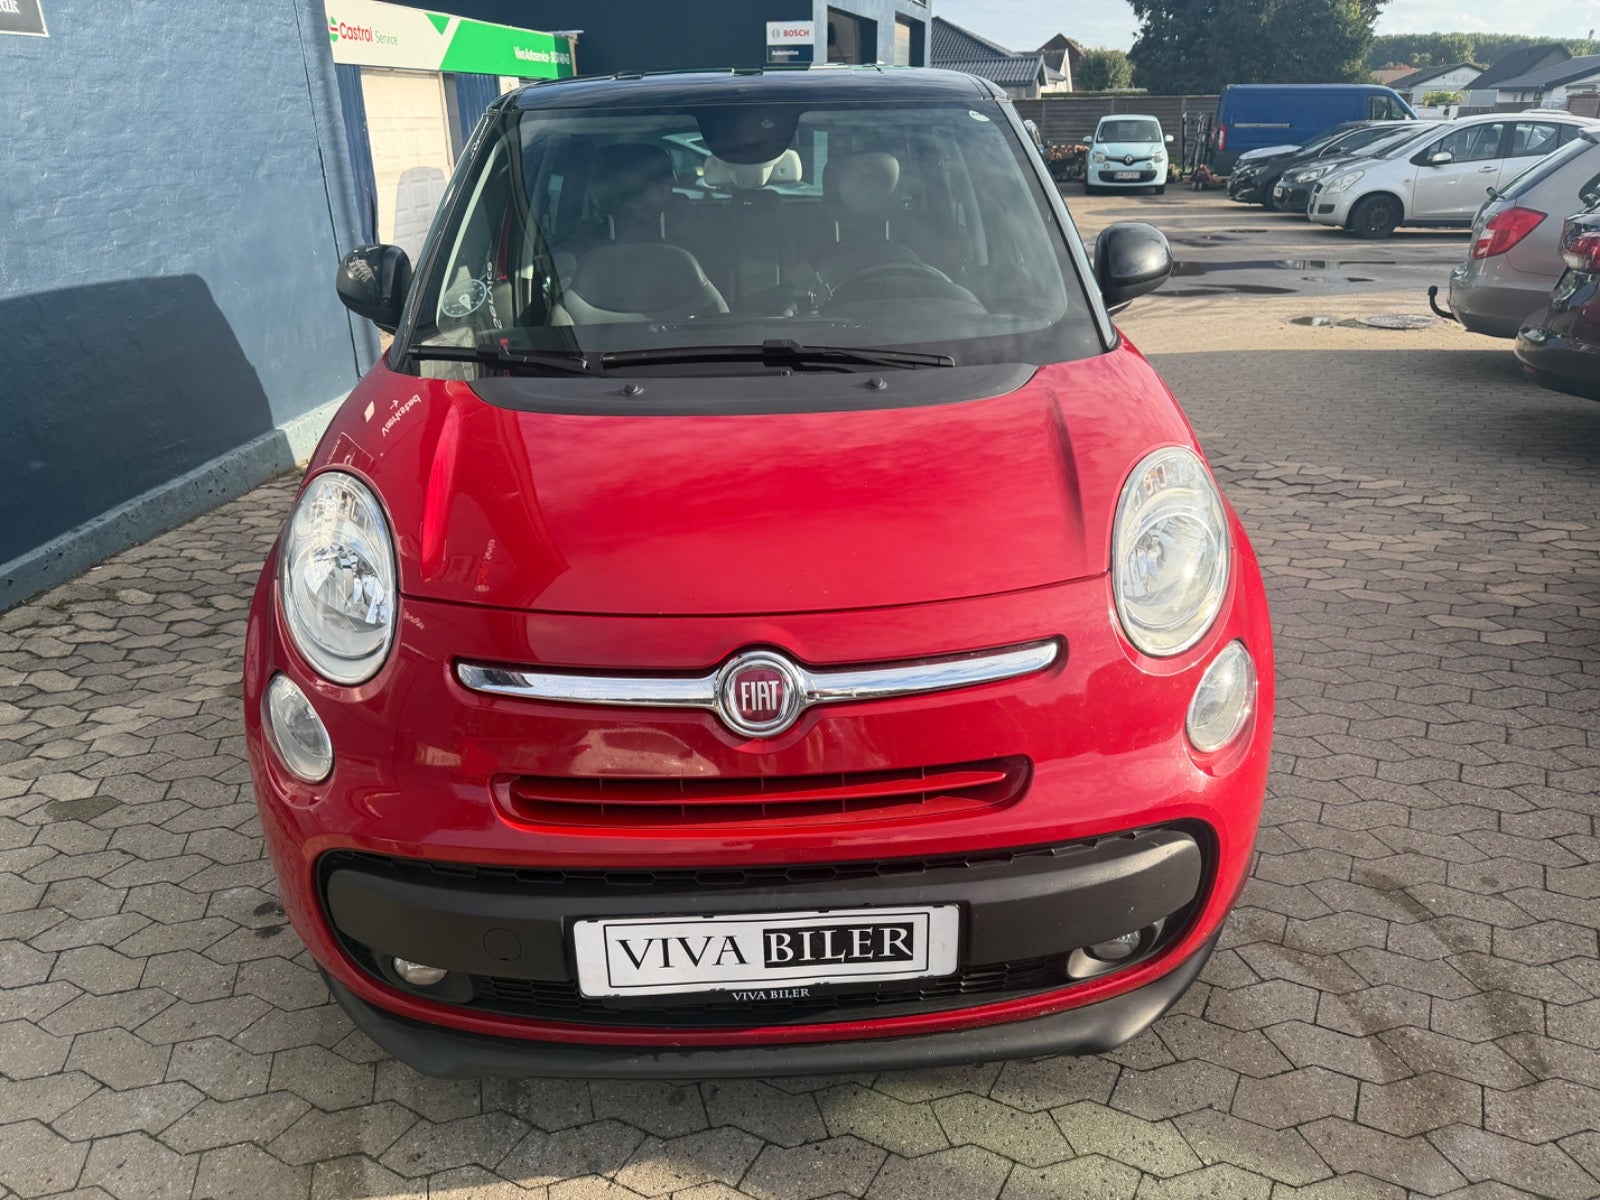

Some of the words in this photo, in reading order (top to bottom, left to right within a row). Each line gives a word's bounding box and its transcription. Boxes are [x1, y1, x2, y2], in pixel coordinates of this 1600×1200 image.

[340, 22, 373, 42] Castrol
[375, 31, 399, 46] Service
[783, 29, 810, 37] BOSCH
[741, 681, 779, 712] FIAT
[616, 935, 751, 970] VIVA
[765, 926, 913, 963] BILER
[732, 990, 766, 1001] VIVA
[770, 988, 810, 999] BILER
